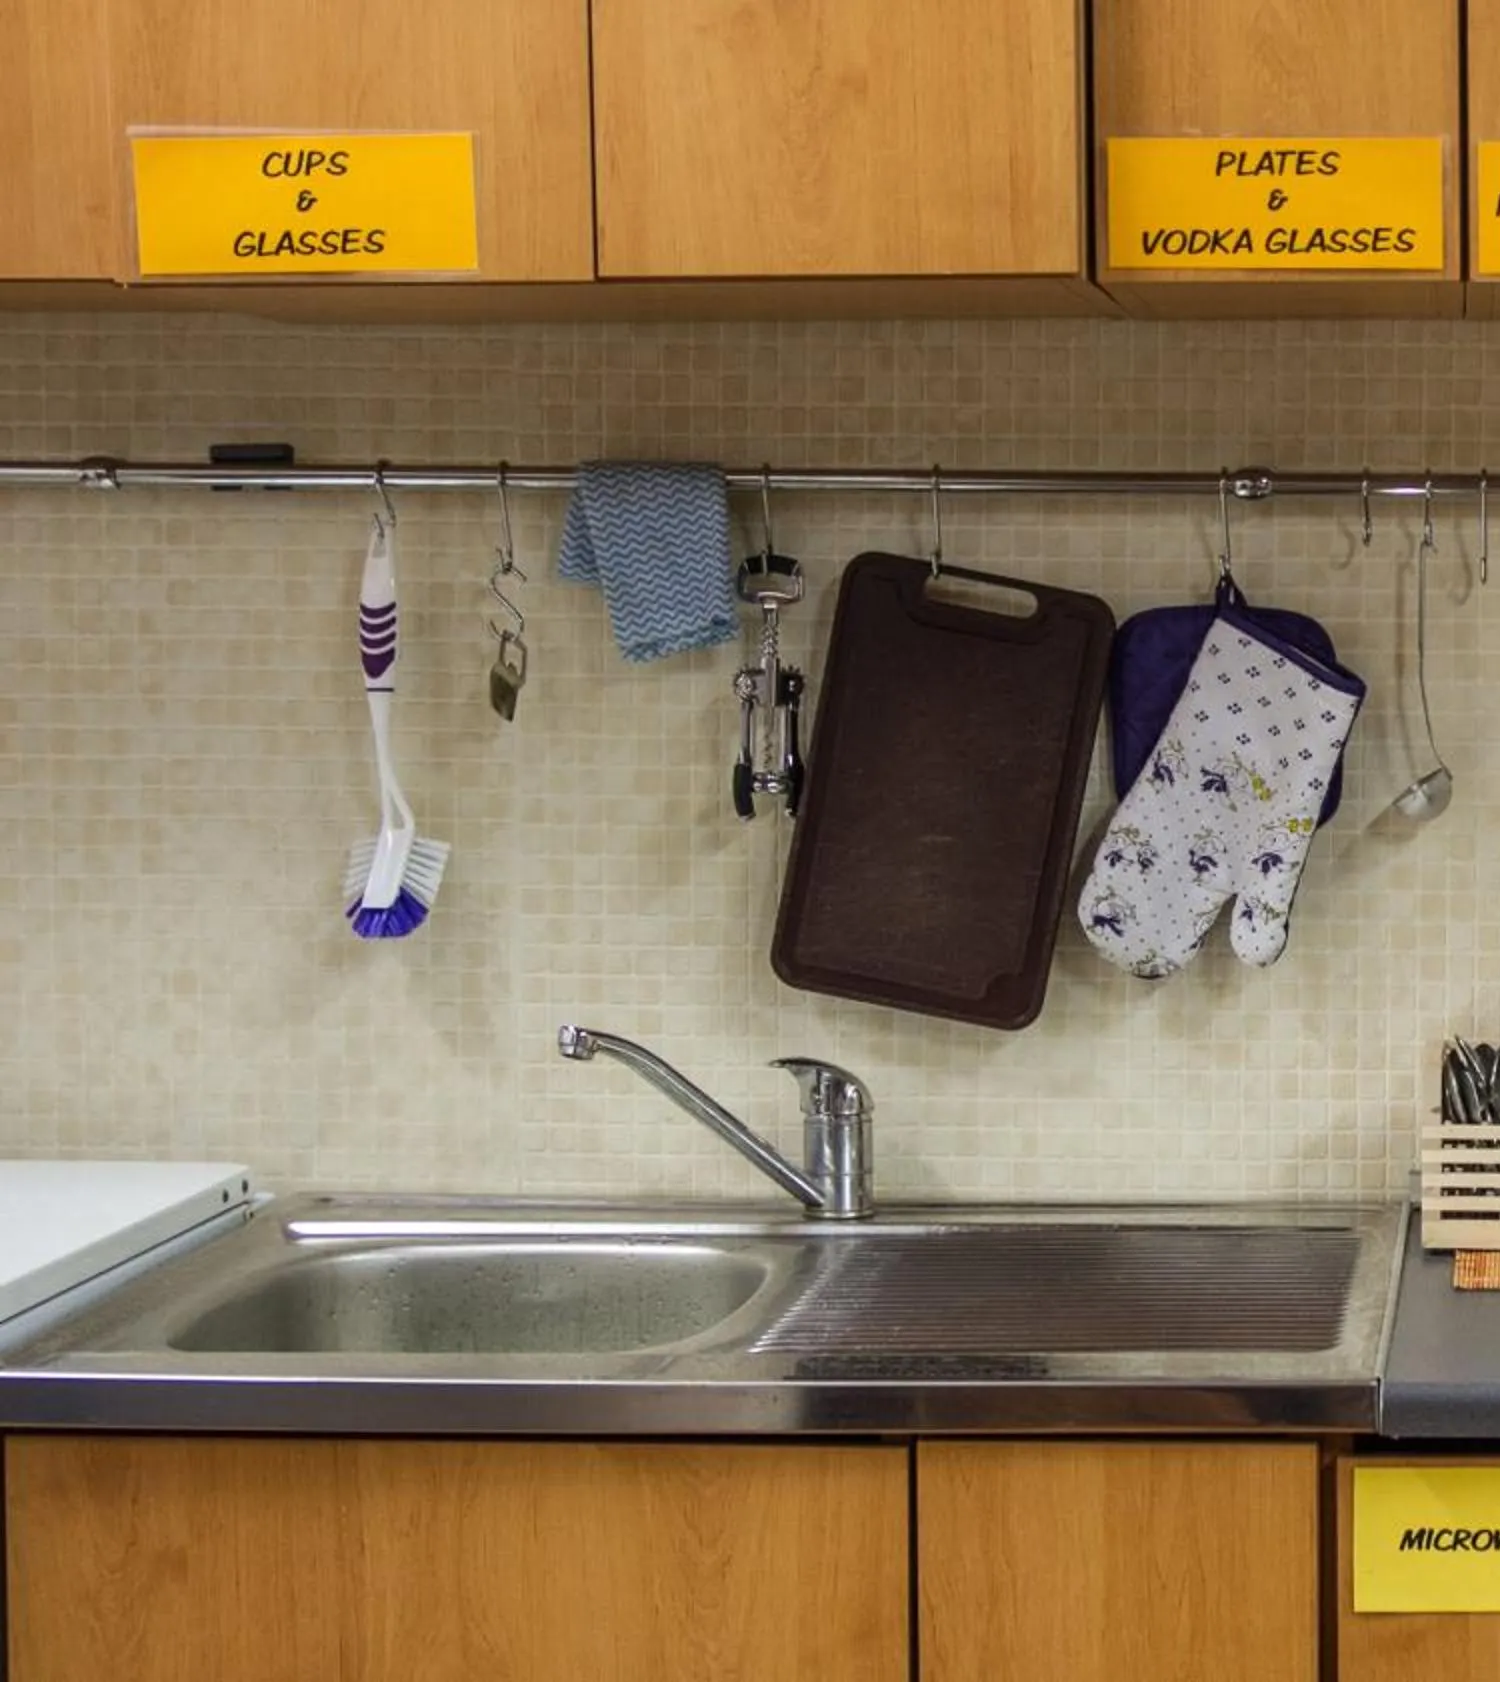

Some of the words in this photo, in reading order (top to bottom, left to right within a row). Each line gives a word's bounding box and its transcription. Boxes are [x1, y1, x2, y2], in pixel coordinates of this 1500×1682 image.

[261, 150, 350, 178] CUPS
[1215, 150, 1341, 177] PLATES
[296, 189, 318, 212] &
[1267, 188, 1289, 211] &
[233, 229, 386, 257] GLASSES
[1141, 228, 1254, 255] VODKA
[1264, 227, 1417, 254] GLASSES
